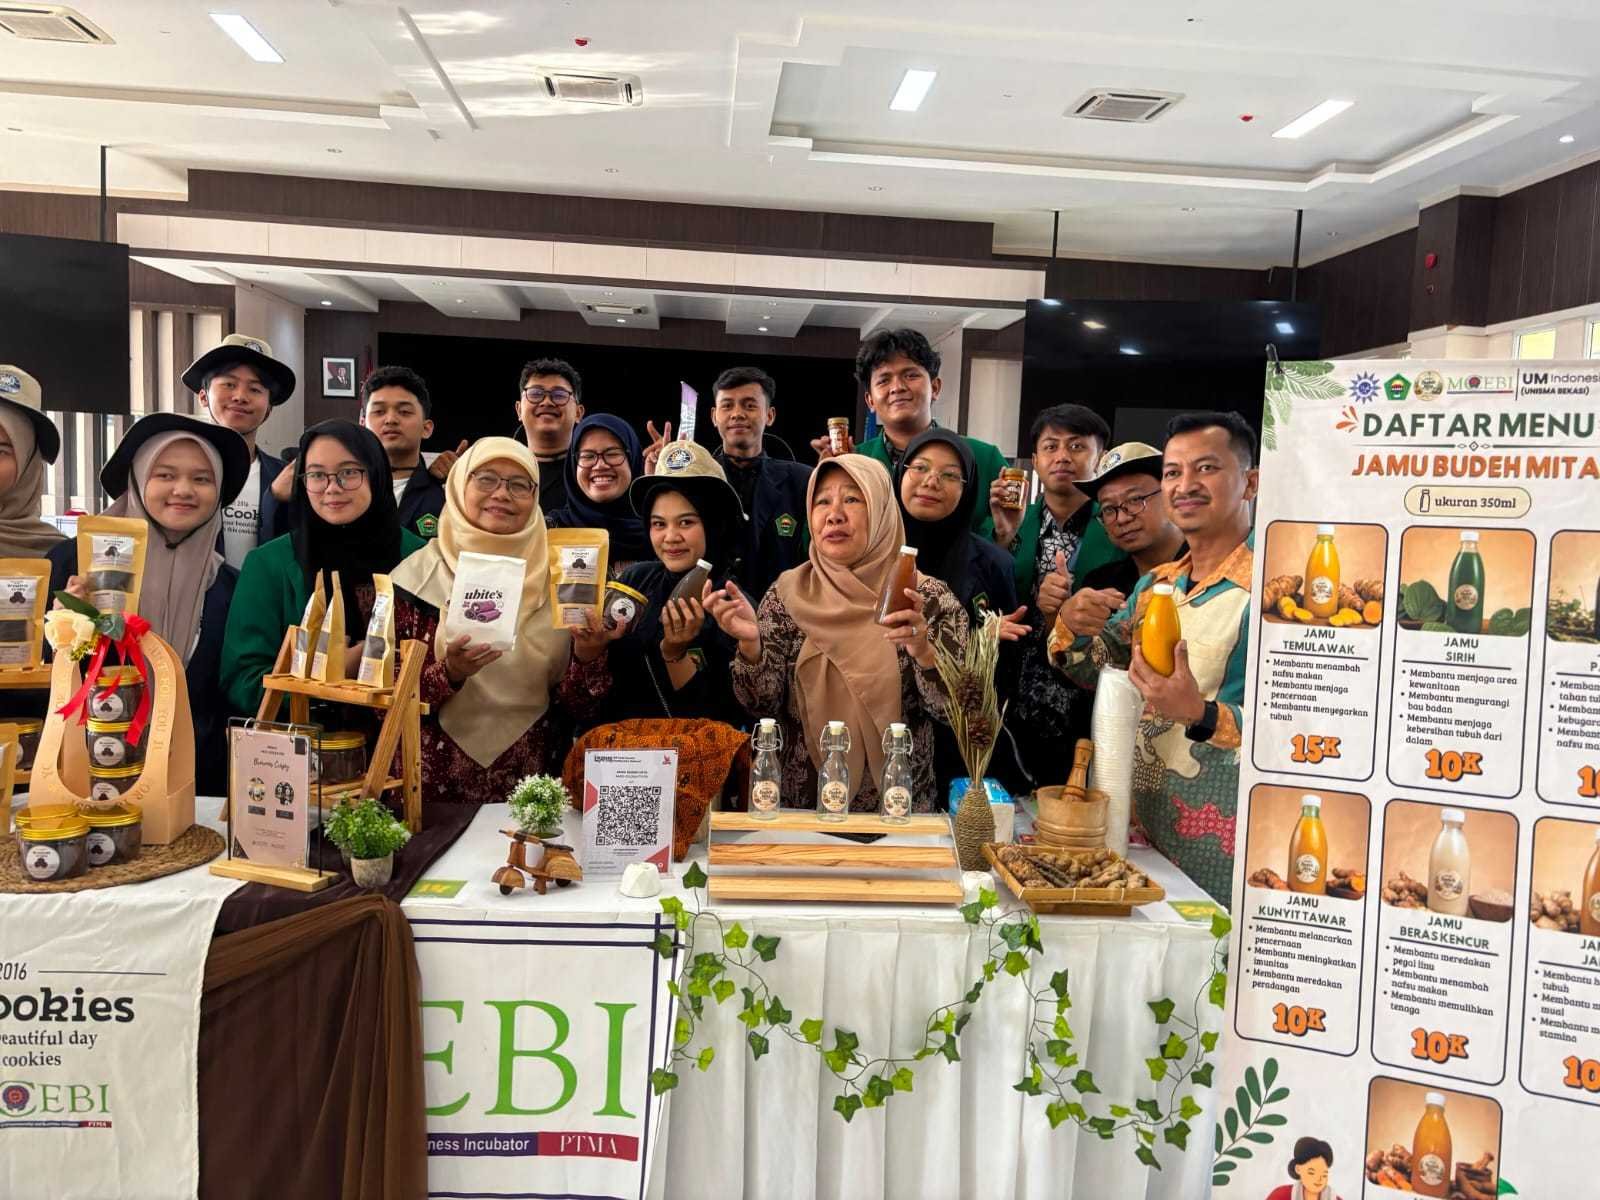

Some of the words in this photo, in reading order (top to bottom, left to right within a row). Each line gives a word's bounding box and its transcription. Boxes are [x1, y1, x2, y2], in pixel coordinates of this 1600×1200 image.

[1522, 373, 1548, 385] UM
[1520, 386, 1555, 396] (UNISMA
[1557, 386, 1590, 396] BEKASI)
[1363, 413, 1491, 437] DAFTAR
[1498, 414, 1595, 438] MENU
[1352, 454, 1428, 477] JAMU
[1432, 455, 1520, 478] BUDEH
[1526, 456, 1600, 480] MITA
[1435, 498, 1477, 508] ukuran
[1480, 497, 1516, 509] 350ml
[464, 588, 503, 600] ubite's
[1303, 628, 1336, 639] JAMU
[1283, 640, 1355, 654] TEMULAWAK
[1444, 637, 1479, 648] JAMU
[1446, 652, 1476, 663] SIRIH
[1273, 658, 1314, 669] Membantu
[1316, 662, 1360, 672] menambah
[1272, 670, 1294, 678] nafsu
[1296, 672, 1322, 680] makan
[1410, 669, 1455, 680] Membantu
[1457, 674, 1494, 684] menjaga
[1272, 680, 1312, 690] Membantu
[1314, 684, 1348, 694] menjaga
[1410, 681, 1460, 692] kewanitaan
[1271, 691, 1317, 702] pencernaan
[1408, 692, 1454, 702] Membantu
[1456, 696, 1510, 709] mengurangi
[1560, 693, 1586, 702] tahan
[1270, 702, 1311, 712] Membantu
[1312, 706, 1368, 717] menyegarkan
[1408, 702, 1424, 711] bau
[1426, 704, 1452, 714] badan
[1270, 712, 1292, 720] tubuh
[1408, 714, 1452, 724] Membantu
[1454, 718, 1492, 730] menjaga
[1406, 725, 1454, 736] kebersihan
[1456, 728, 1481, 738] tubuh
[1484, 732, 1502, 741] dari
[1406, 736, 1432, 746] dalam
[1556, 740, 1582, 749] nafsu
[1291, 734, 1342, 764] 15K
[1424, 748, 1483, 782] 10K
[1286, 896, 1319, 908] JAMU
[1258, 906, 1300, 919] KUNYIT
[1301, 912, 1346, 926] TAWAR
[1428, 916, 1462, 930] JAMU
[1255, 936, 1302, 949] pencernaan
[1256, 925, 1297, 937] Membantu
[1299, 931, 1352, 946] melancarkan
[1400, 926, 1438, 941] BERAS
[1440, 932, 1489, 950] KENCUR
[1254, 947, 1296, 959] Membantu
[1298, 954, 1356, 969] meningkatkan
[1254, 958, 1289, 969] imunitas
[1394, 946, 1439, 960] Membantu
[1440, 954, 1491, 968] meredakan
[1393, 958, 1416, 968] pegal
[1418, 961, 1435, 971] linu
[1253, 968, 1294, 981] Membantu
[1296, 974, 1342, 989] meredakan
[1392, 968, 1438, 983] Membantu
[1440, 976, 1489, 992] menambah
[1543, 970, 1592, 984] Membantu
[1252, 980, 1300, 993] peradangan
[1392, 980, 1416, 990] nafsu
[1418, 984, 1448, 996] makan
[1542, 982, 1570, 993] tubuh
[1391, 990, 1436, 1006] Membantu
[1438, 999, 1494, 1016] memulihkan
[1542, 993, 1590, 1008] Membantu
[1390, 1002, 1420, 1016] tenaga
[1541, 1006, 1564, 1016] mual
[1272, 1002, 1326, 1037] 10K
[1540, 1017, 1589, 1032] Membantu
[0, 1030, 62, 1046] eautiful
[69, 1030, 98, 1050] day
[1539, 1030, 1576, 1043] stamina
[1411, 1027, 1470, 1064] 10K
[2, 1052, 62, 1067] cookies
[464, 1137, 530, 1152] Incubator
[560, 1135, 617, 1155] PTMA
